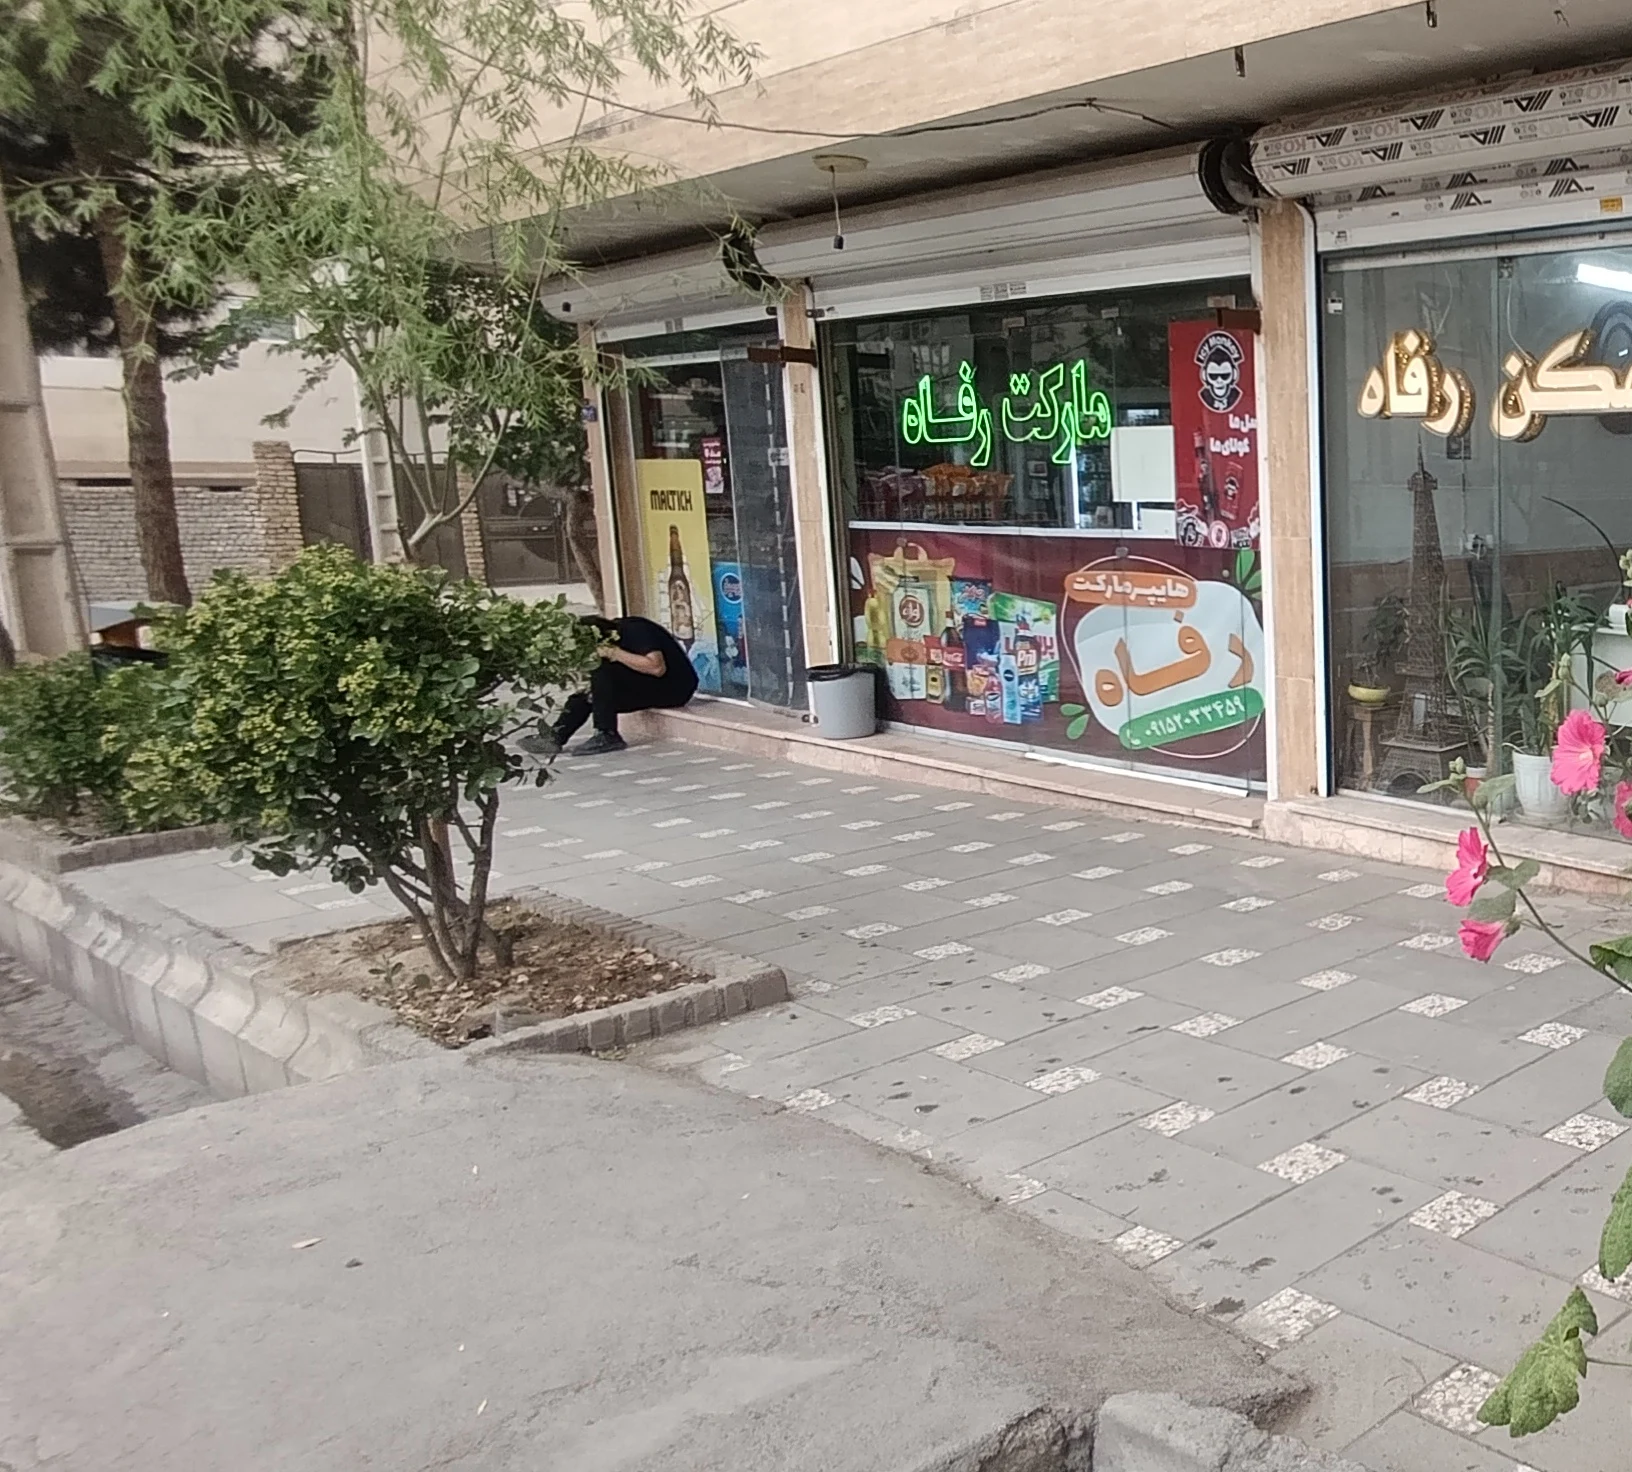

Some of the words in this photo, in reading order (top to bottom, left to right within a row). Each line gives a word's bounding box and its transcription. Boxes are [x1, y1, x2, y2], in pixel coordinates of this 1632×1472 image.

[1198, 343, 1210, 360] Icy
[1208, 336, 1240, 359] Monkey
[1356, 329, 1475, 438] رفاه
[902, 360, 991, 467] رفاه
[1001, 358, 1113, 465] مارکت
[1073, 575, 1190, 605] هایپرمارکت
[1095, 610, 1254, 707] رفاه
[1145, 695, 1245, 736] ۰۹۱۵۲۰۳۳۴۵۹
